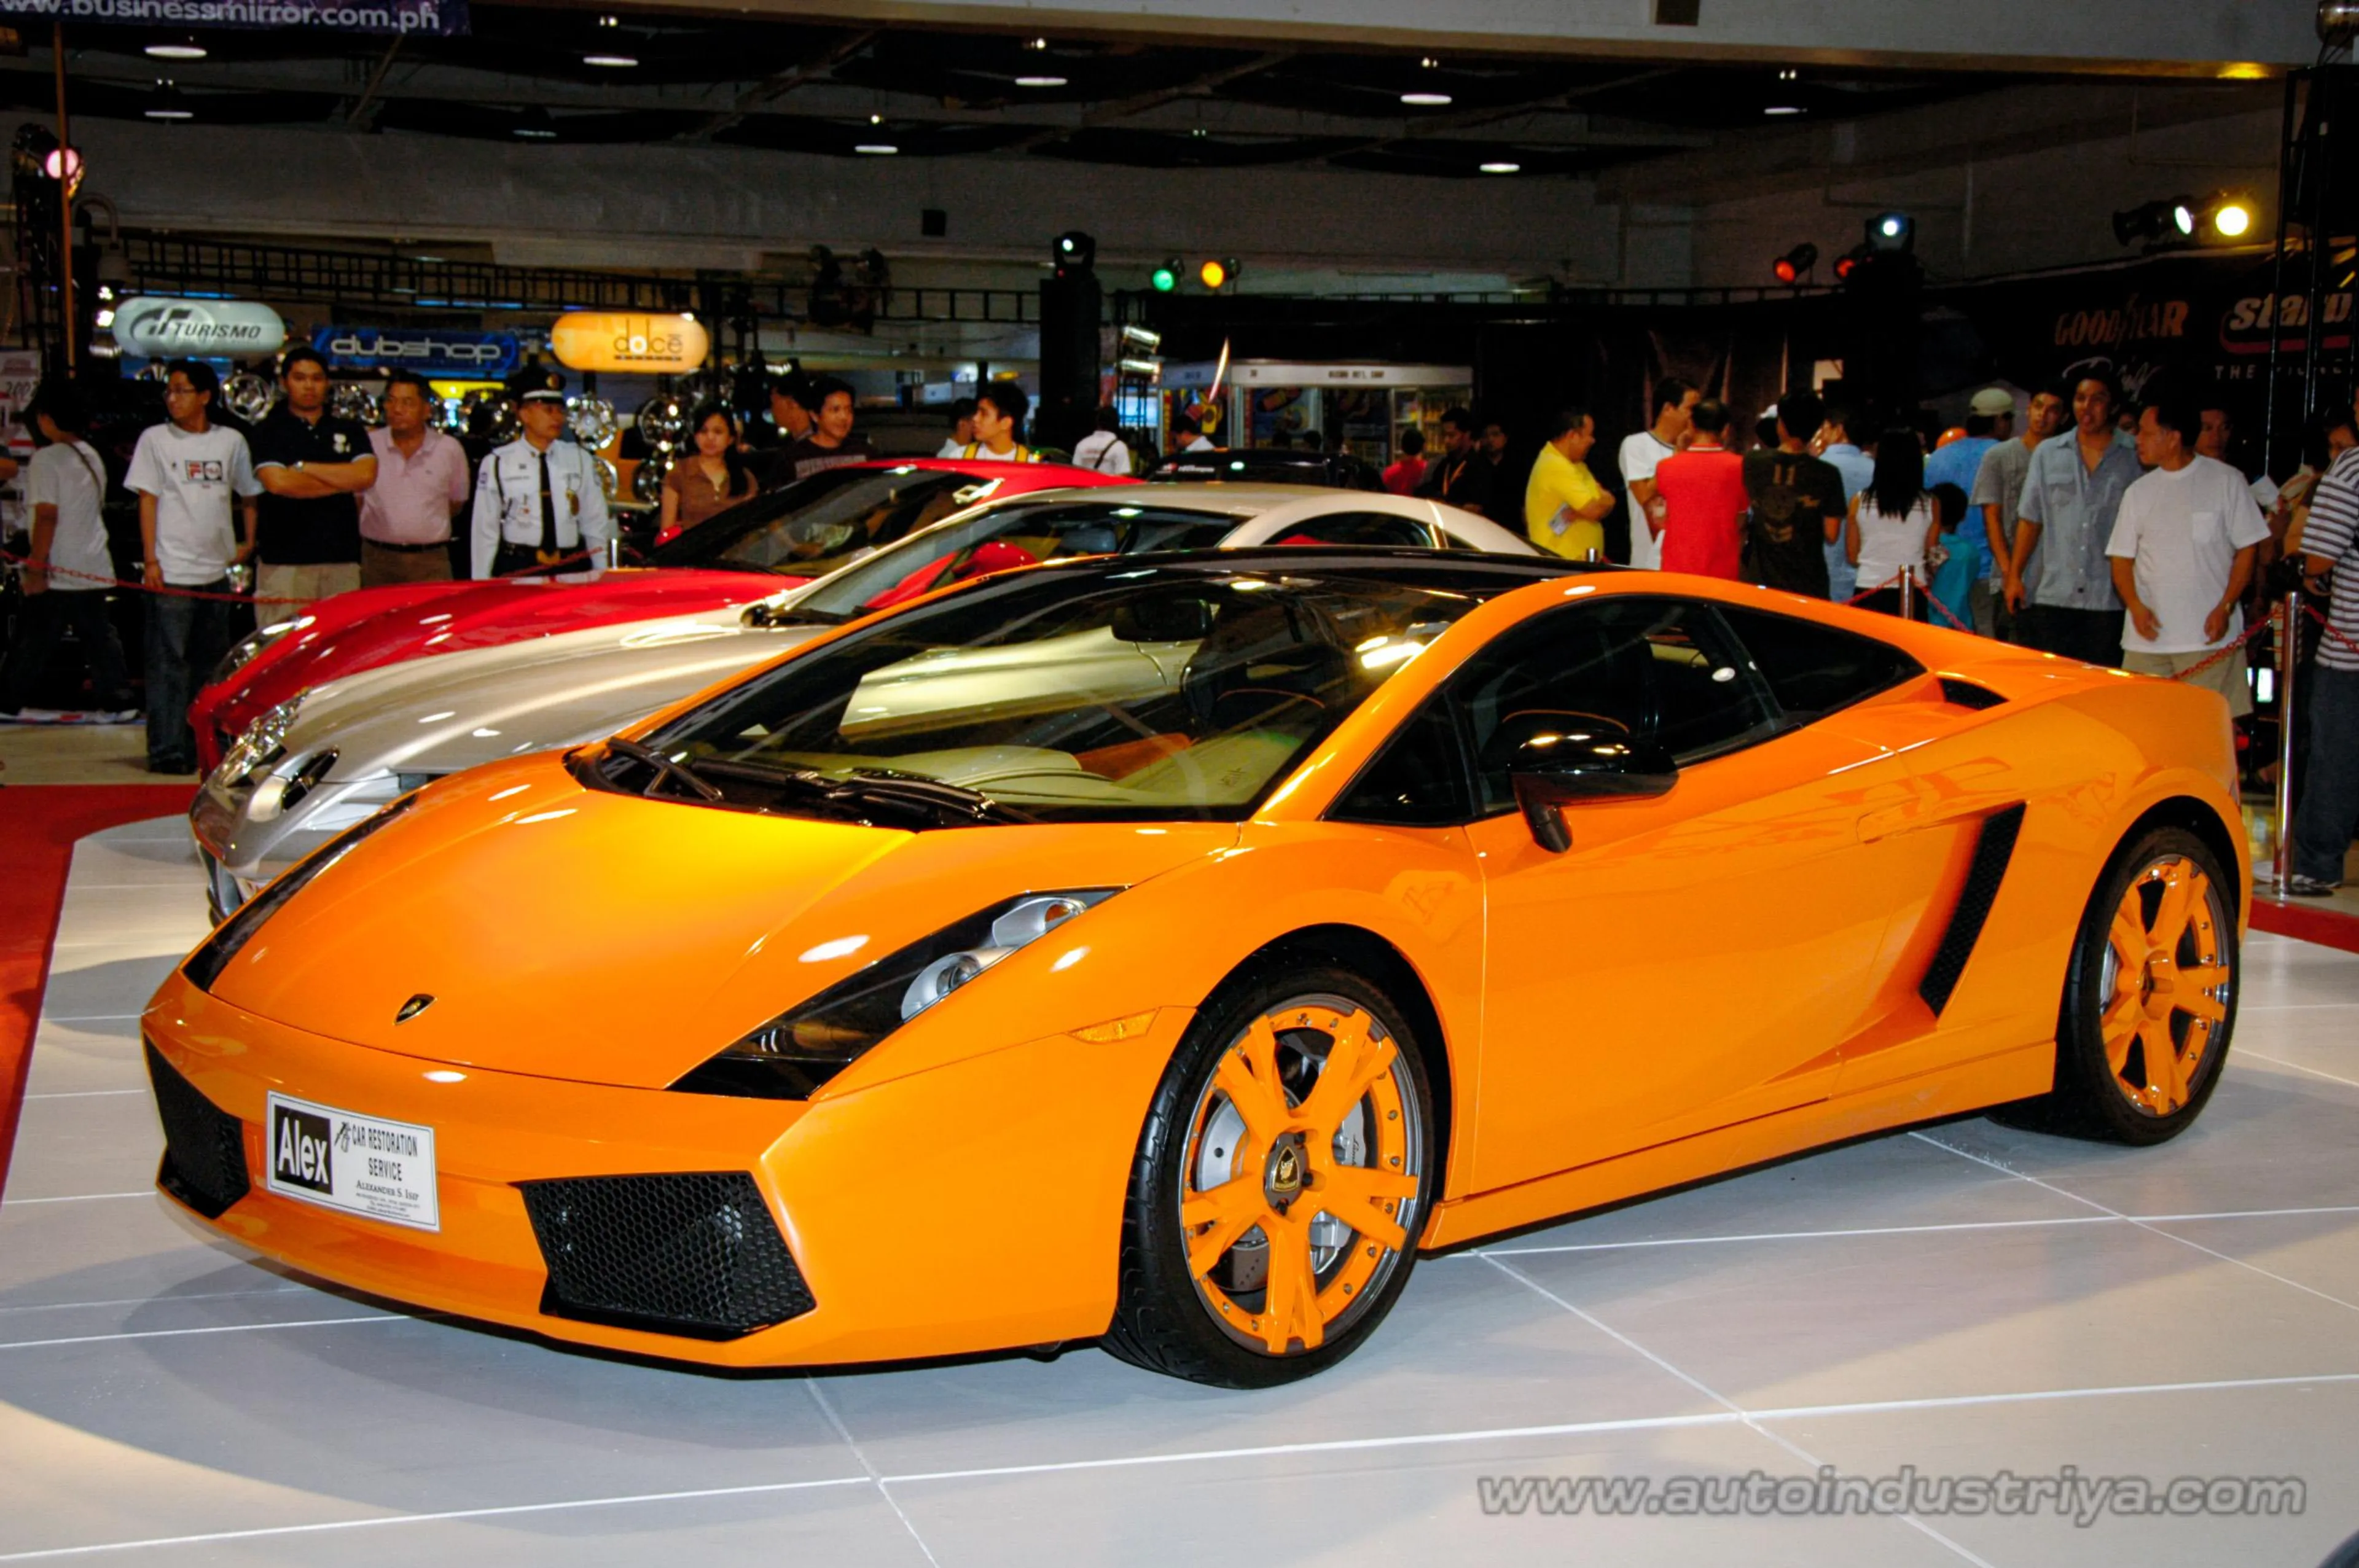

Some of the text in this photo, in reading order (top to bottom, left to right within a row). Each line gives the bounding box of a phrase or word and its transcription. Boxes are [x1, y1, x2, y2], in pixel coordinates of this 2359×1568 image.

[175, 323, 261, 338] TURISMO
[331, 335, 501, 364] dubshop
[2213, 364, 2257, 381] THE
[278, 1117, 329, 1185] Alex
[352, 1124, 418, 1157] CAR RESTORATION
[368, 1157, 403, 1182] SERVICE
